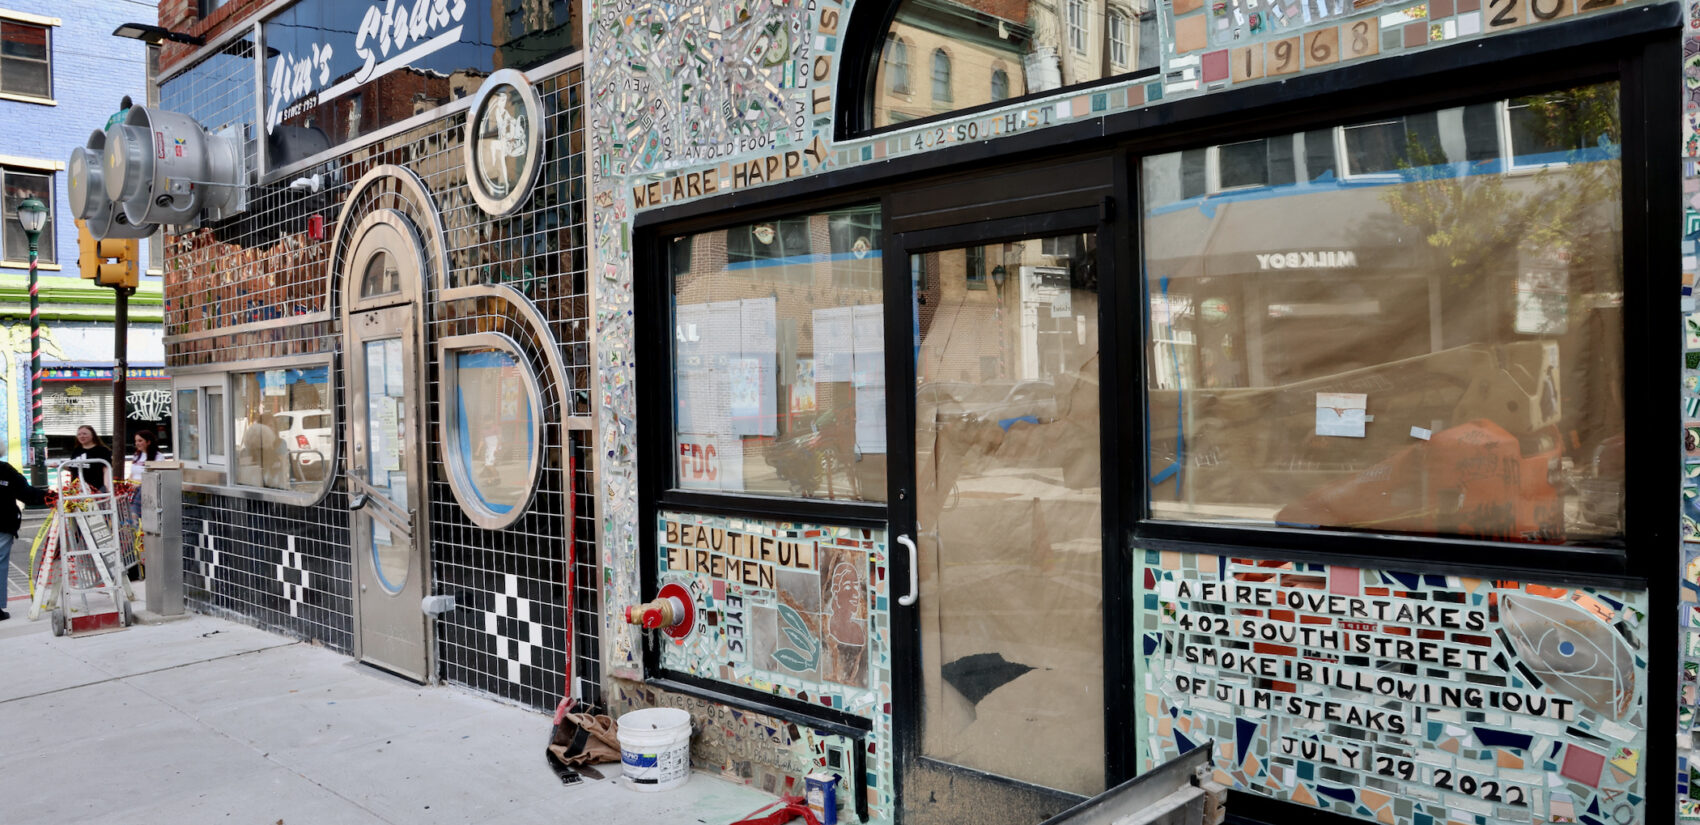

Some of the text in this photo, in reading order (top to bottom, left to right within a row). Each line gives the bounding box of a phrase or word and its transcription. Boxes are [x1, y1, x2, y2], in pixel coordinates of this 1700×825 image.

[1489, 0, 1617, 27] 20
[267, 0, 467, 135] Jim's Steaks
[798, 32, 811, 88] LONG
[1246, 21, 1369, 77] 1968
[283, 104, 302, 121] SINCE
[633, 184, 661, 208] WE
[673, 169, 715, 199] ARE
[734, 136, 820, 189] HAPPY
[812, 56, 830, 115] TO
[654, 98, 672, 160] WORLD
[794, 102, 805, 141] HOW
[914, 106, 1053, 149] 402 SOUTH ST
[685, 134, 775, 158] AN OLD FOOL
[680, 443, 717, 480] FDC
[666, 521, 809, 568] BEAUTIFUL
[667, 548, 773, 589] FIREMEN
[690, 581, 706, 634] EYES
[726, 595, 743, 653] EYES
[1177, 581, 1485, 631] A FIRE OVERTAKES
[1179, 614, 1488, 670] 402 SOUTH STREET
[1175, 675, 1405, 734] OF JIM STEAKS
[1185, 646, 1573, 719] SMOKE BILLOWING OUT
[1281, 736, 1528, 807] JULY 29 2022
